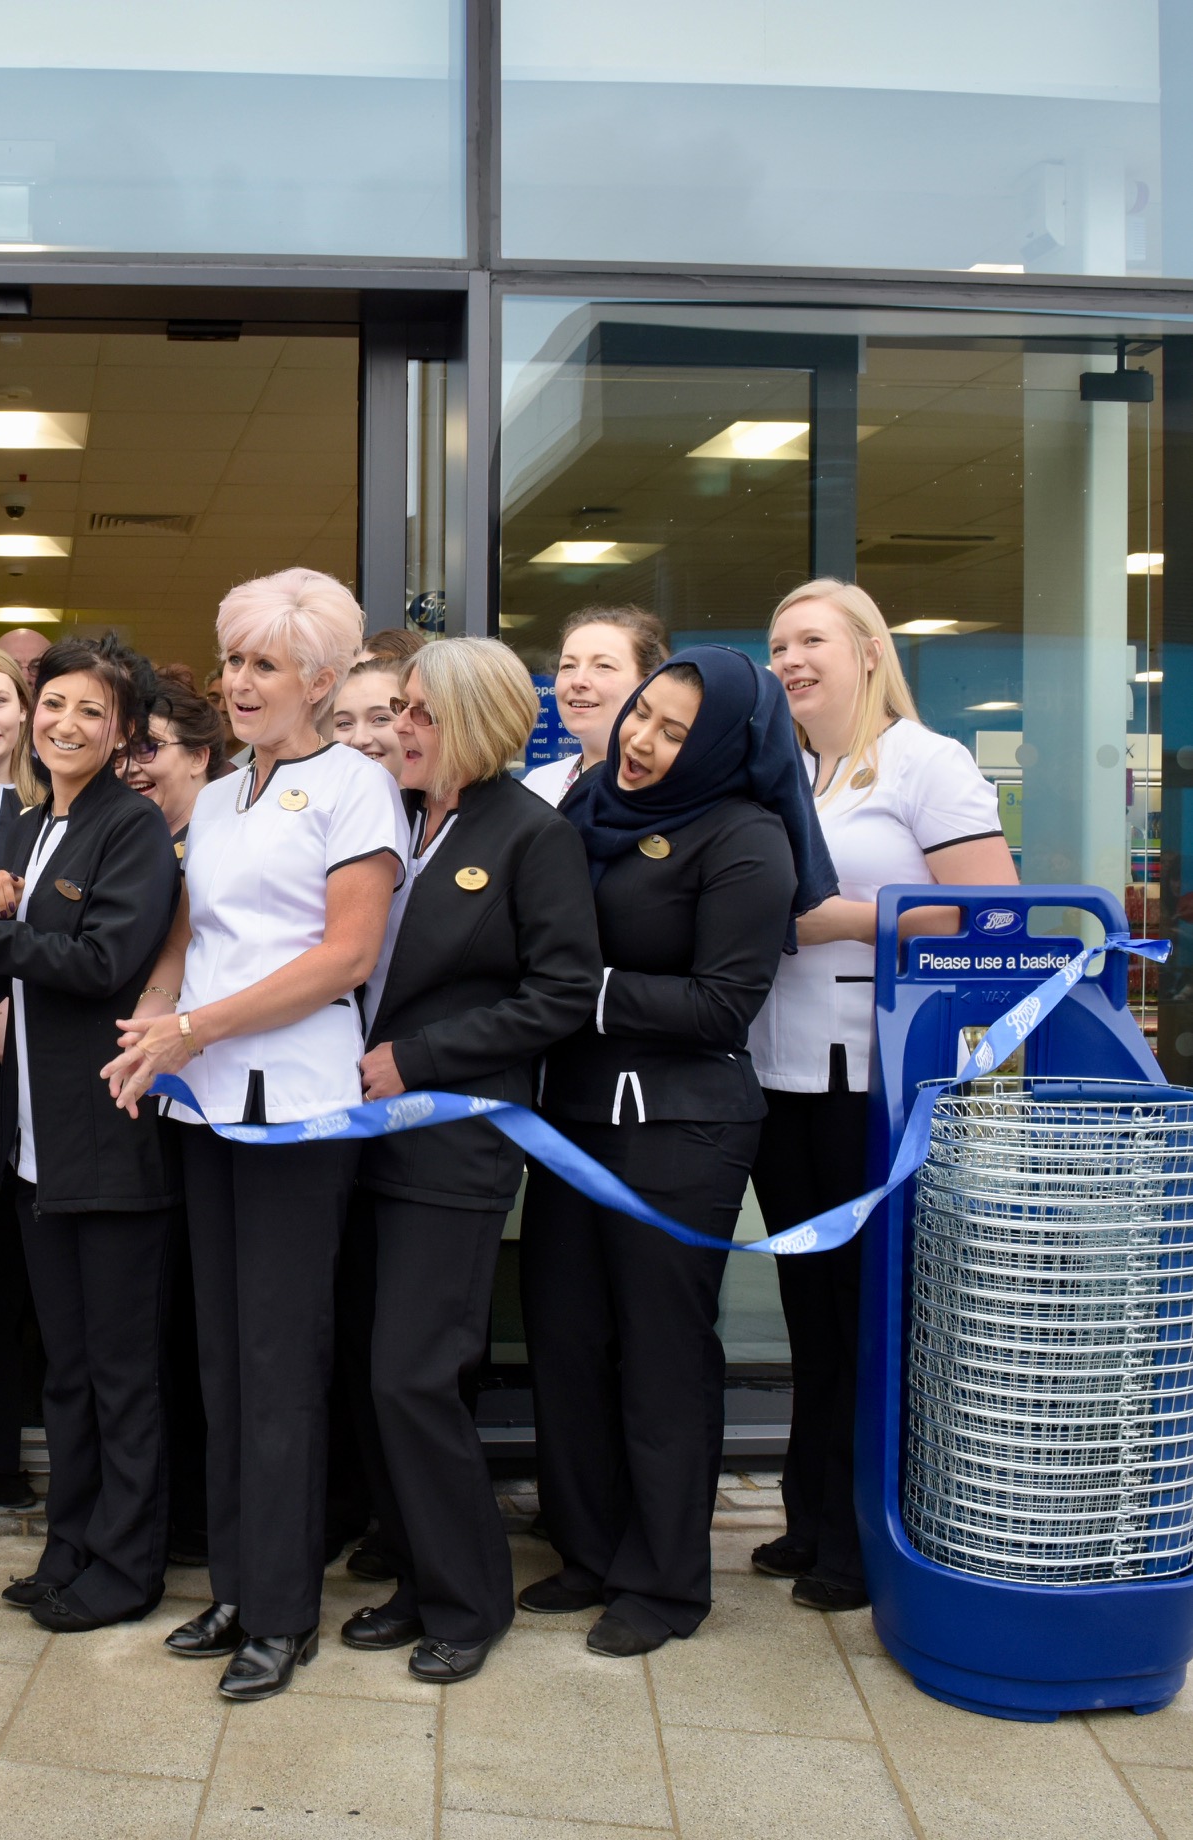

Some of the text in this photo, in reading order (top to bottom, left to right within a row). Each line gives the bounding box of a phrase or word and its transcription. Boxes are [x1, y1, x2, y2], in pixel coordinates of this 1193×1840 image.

[535, 686, 555, 697] ope
[984, 912, 1015, 930] Boots
[920, 953, 1071, 970] Please use a basket
[1006, 996, 1041, 1041] Boots
